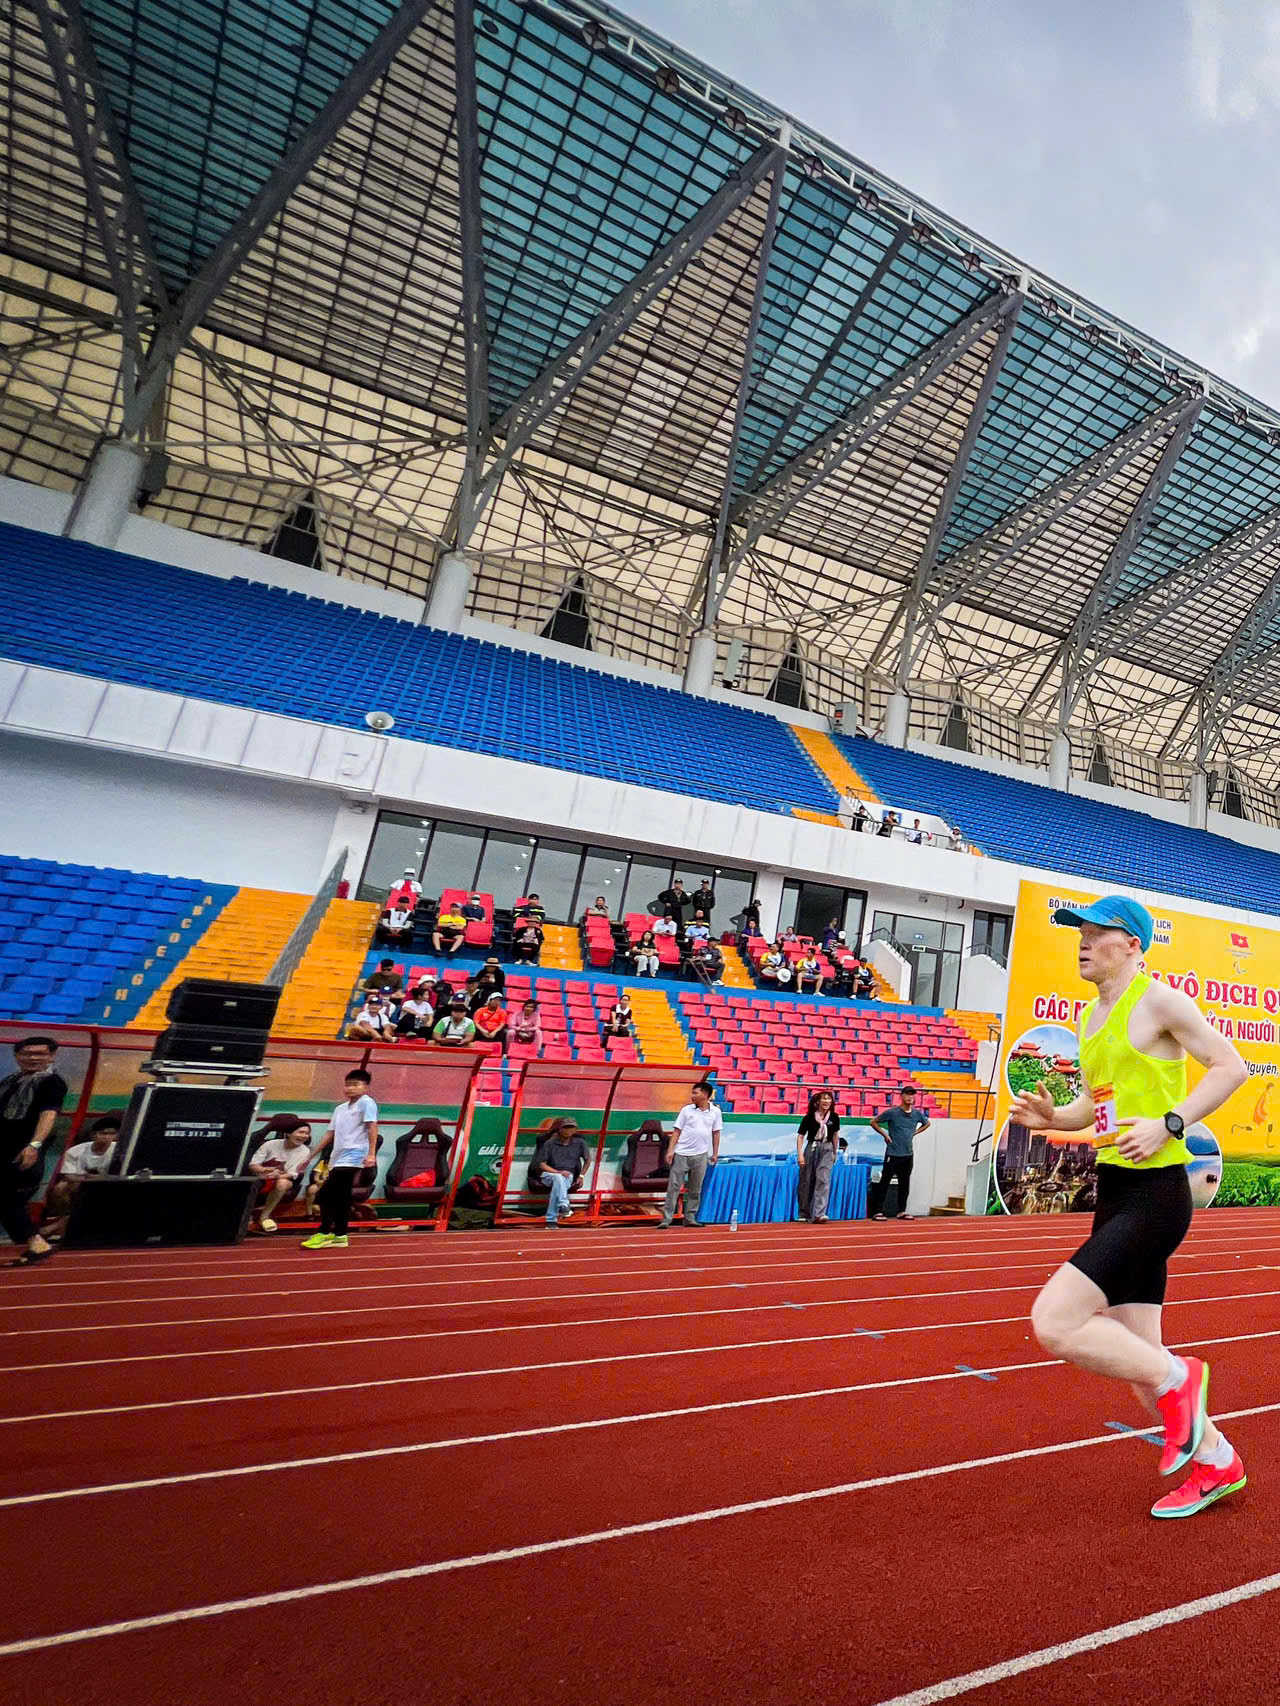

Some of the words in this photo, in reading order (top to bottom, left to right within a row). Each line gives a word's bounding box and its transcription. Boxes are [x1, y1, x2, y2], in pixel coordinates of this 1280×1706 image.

[1034, 994, 1068, 1021] CÁC
[1206, 980, 1257, 1008] ĐỊCH
[1237, 1020, 1275, 1042] NGƯỜI
